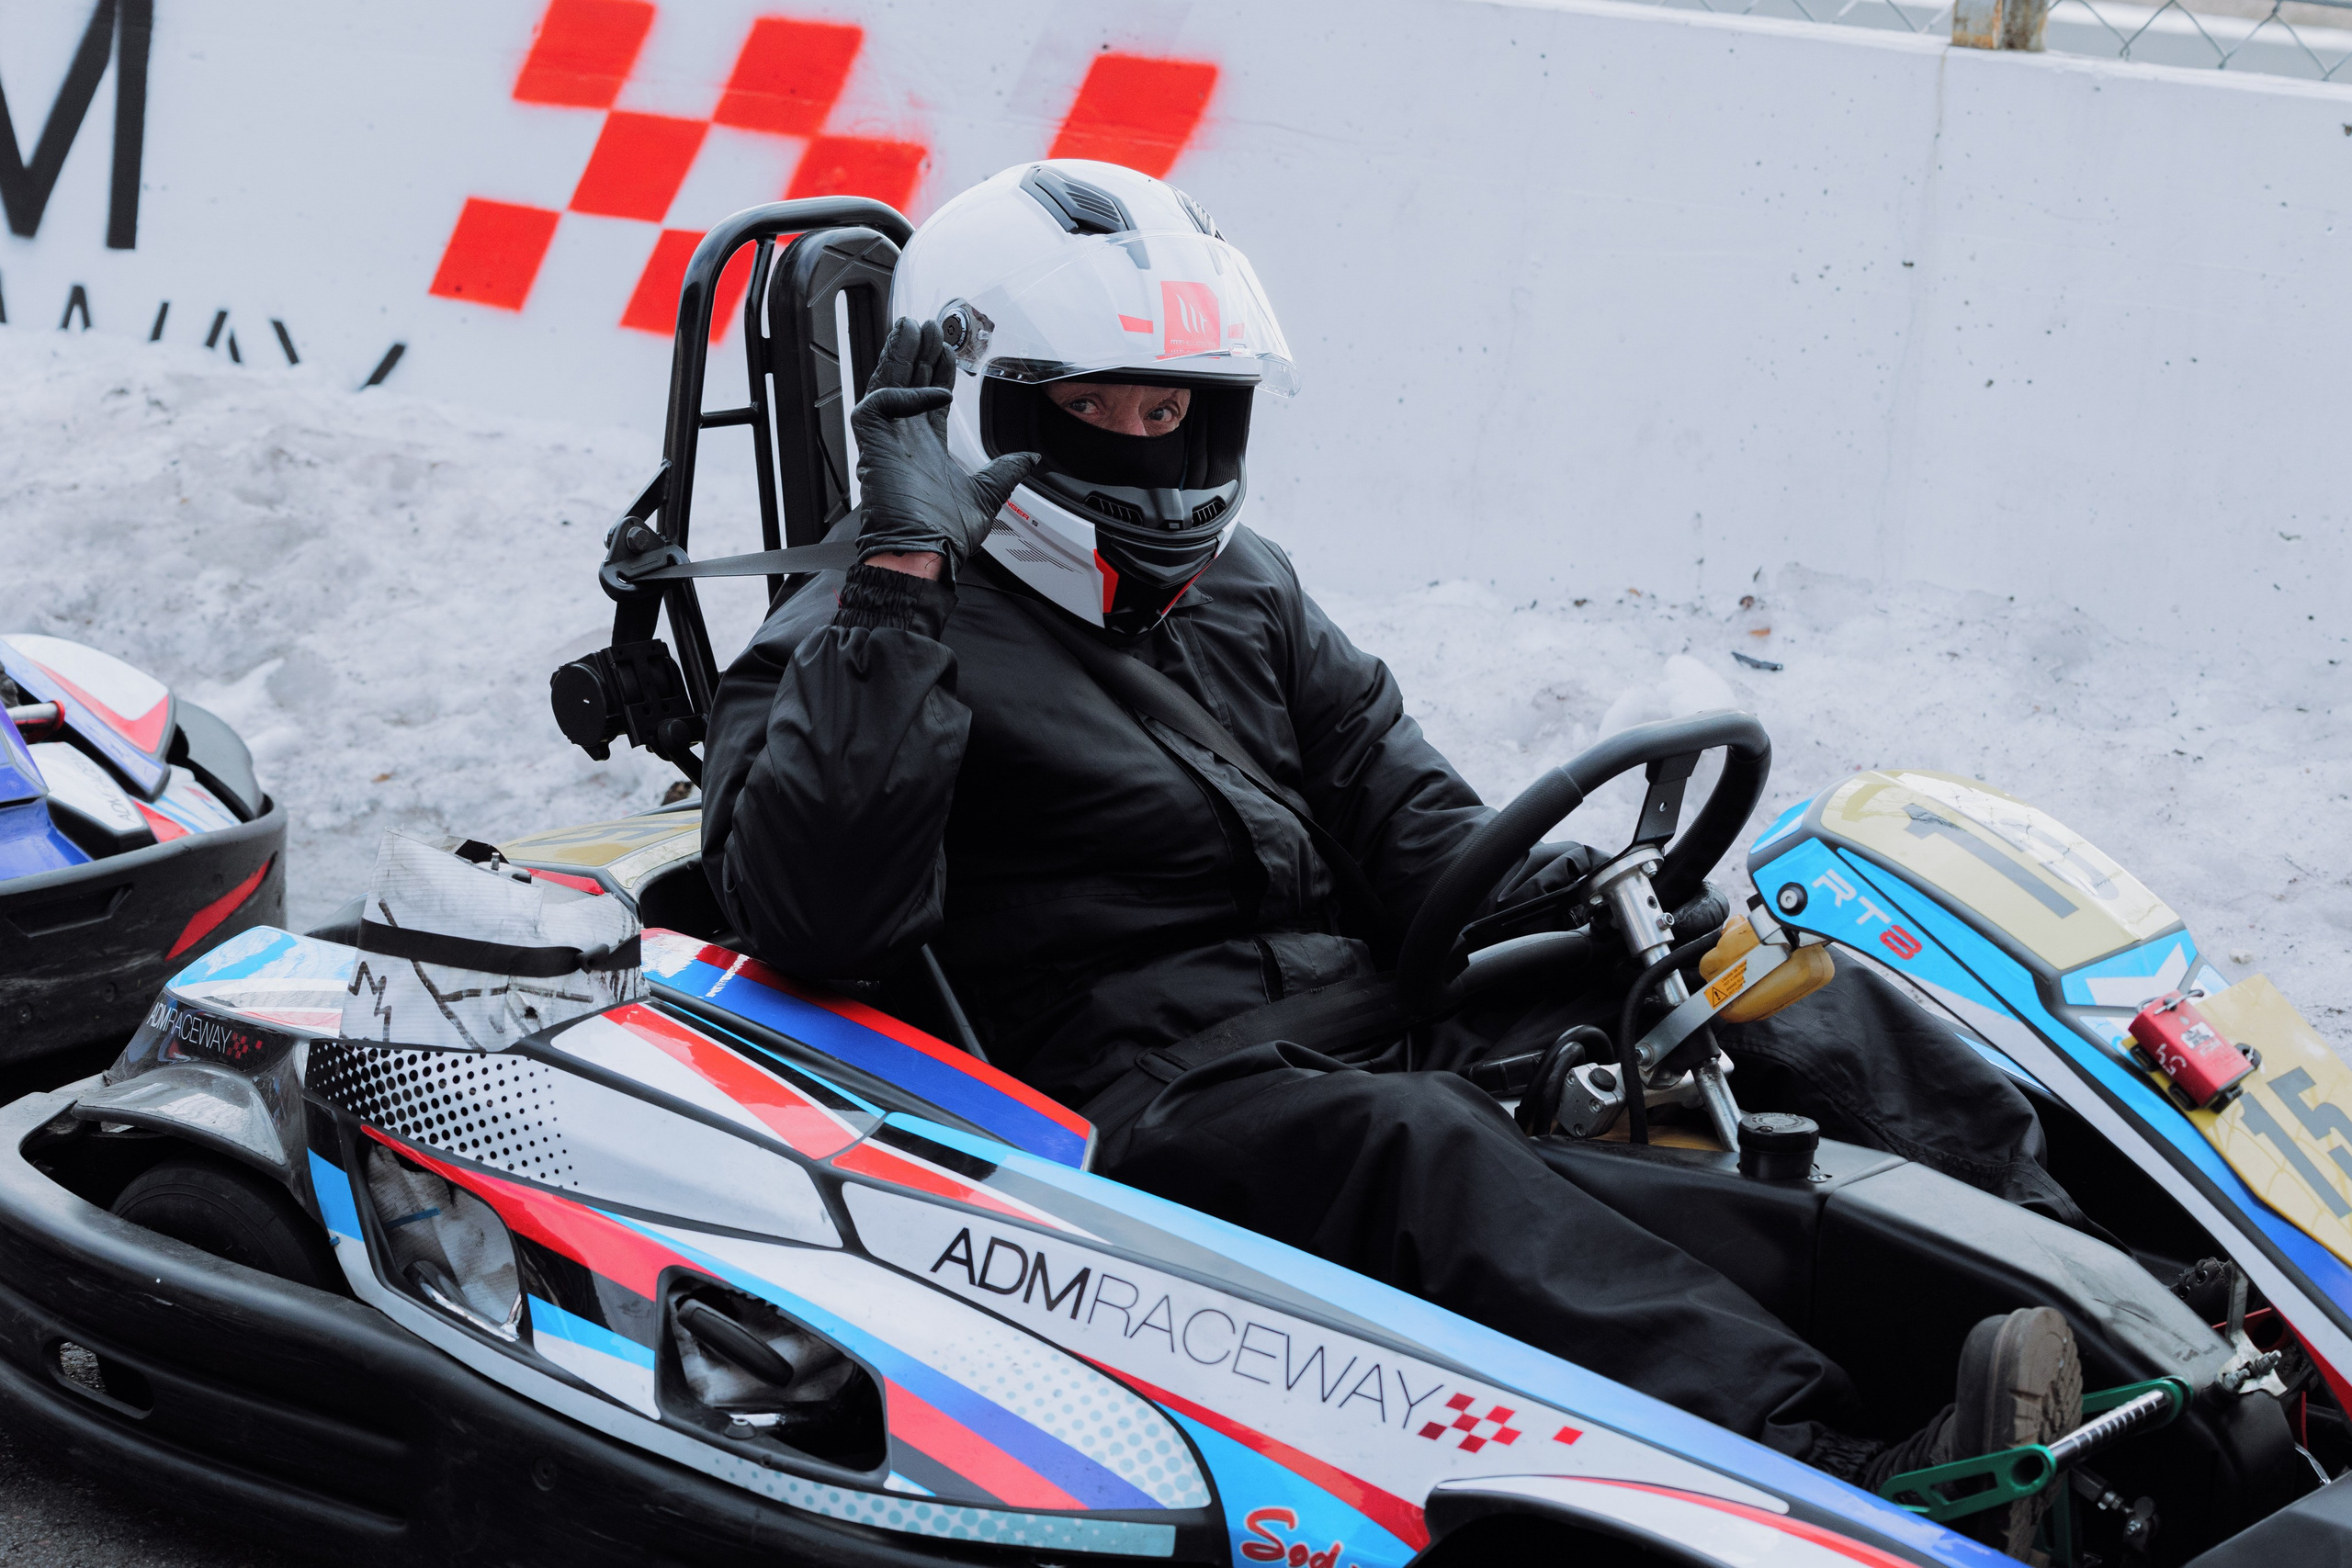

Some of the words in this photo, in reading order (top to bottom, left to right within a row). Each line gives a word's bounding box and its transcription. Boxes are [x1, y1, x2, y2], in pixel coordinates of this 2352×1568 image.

[1005, 500, 1030, 521] NGER
[1812, 868, 1923, 961] RT8
[147, 1002, 232, 1054] ADMRACEWAY
[2239, 1066, 2352, 1219] 15
[930, 1227, 1444, 1429] ADMRACEWAY
[1241, 1506, 1362, 1568] Sod
